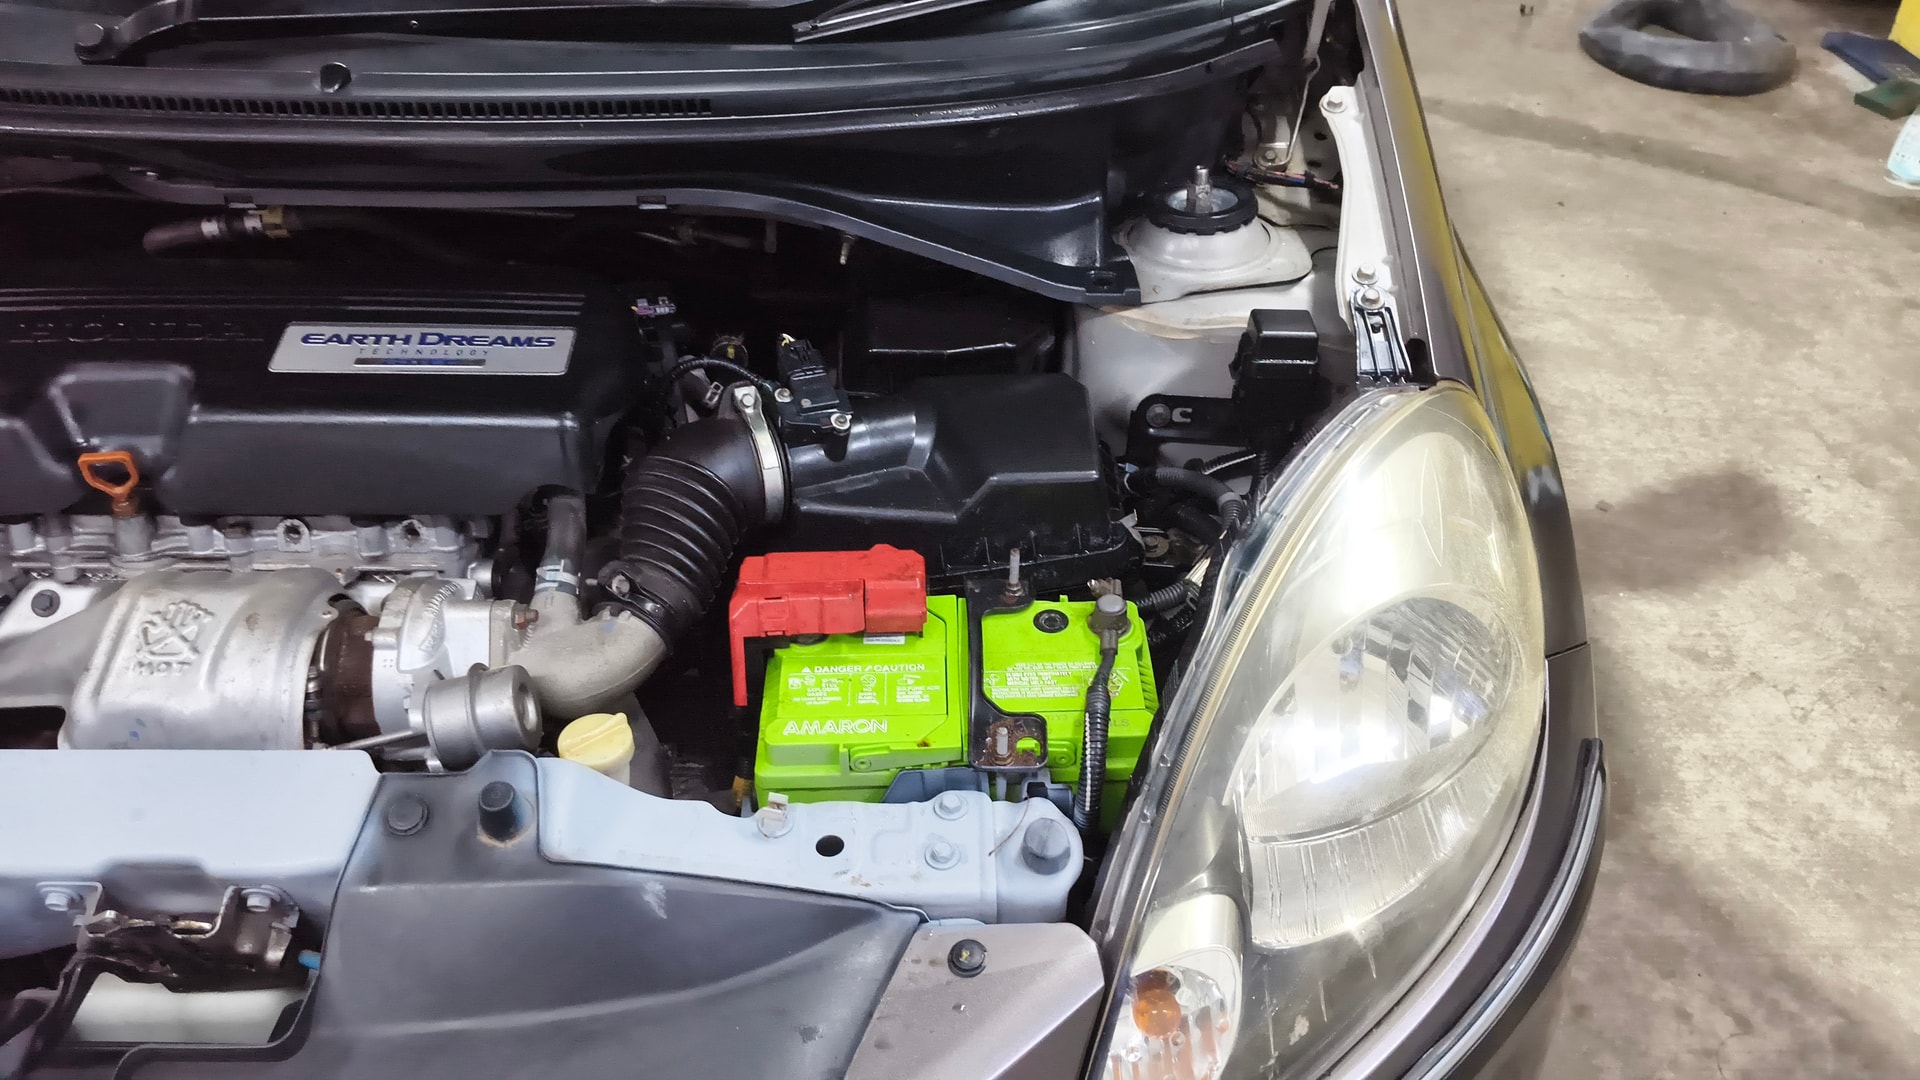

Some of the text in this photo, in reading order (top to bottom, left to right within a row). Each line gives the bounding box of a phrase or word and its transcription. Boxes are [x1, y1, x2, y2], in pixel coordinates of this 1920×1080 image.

[300, 333, 412, 346] EARTH
[358, 348, 489, 357] TECHNOLOGY
[814, 665, 862, 673] DANGER
[783, 719, 888, 736] AMARON
